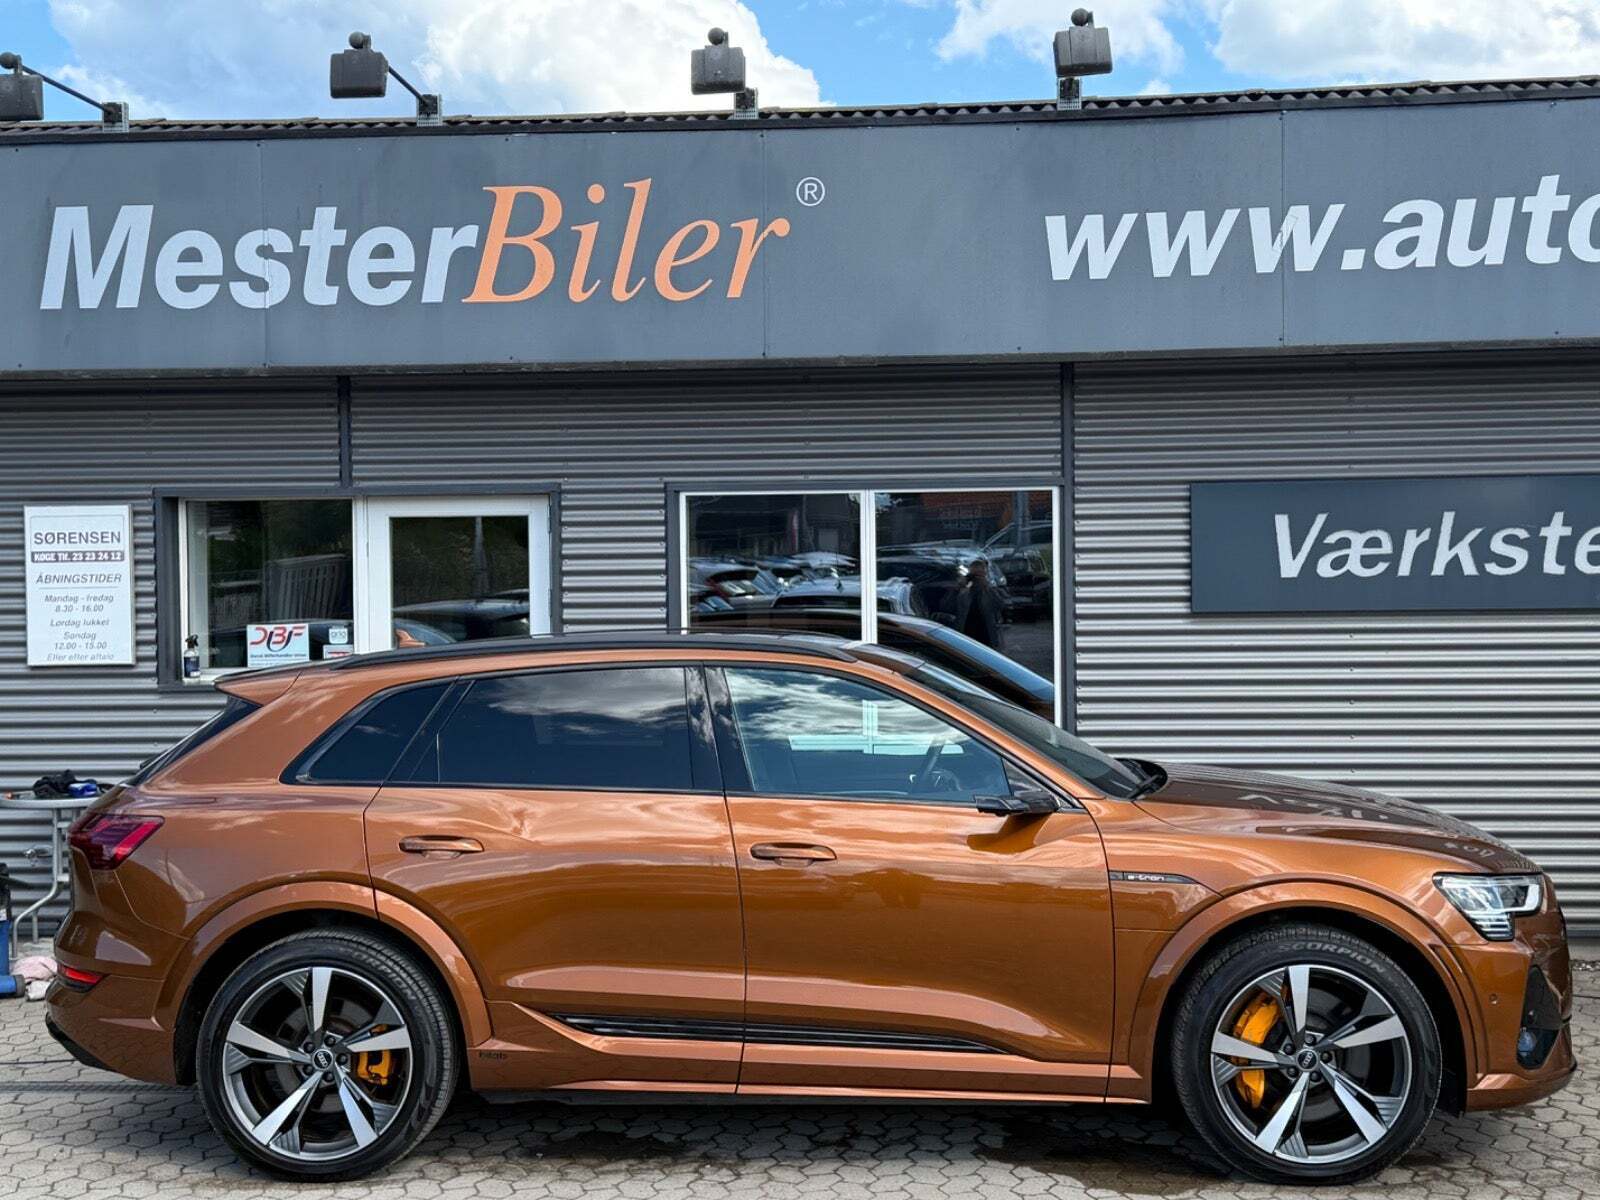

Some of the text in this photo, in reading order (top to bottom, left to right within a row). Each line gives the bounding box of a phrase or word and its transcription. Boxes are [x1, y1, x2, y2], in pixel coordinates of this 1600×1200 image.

[39, 177, 791, 311] MesterBiler
[33, 531, 121, 545] SØRENSEN
[36, 572, 122, 584] ÅBNINGSTIDER
[44, 594, 77, 604] Mandag
[1279, 941, 1386, 973] SCORPION
